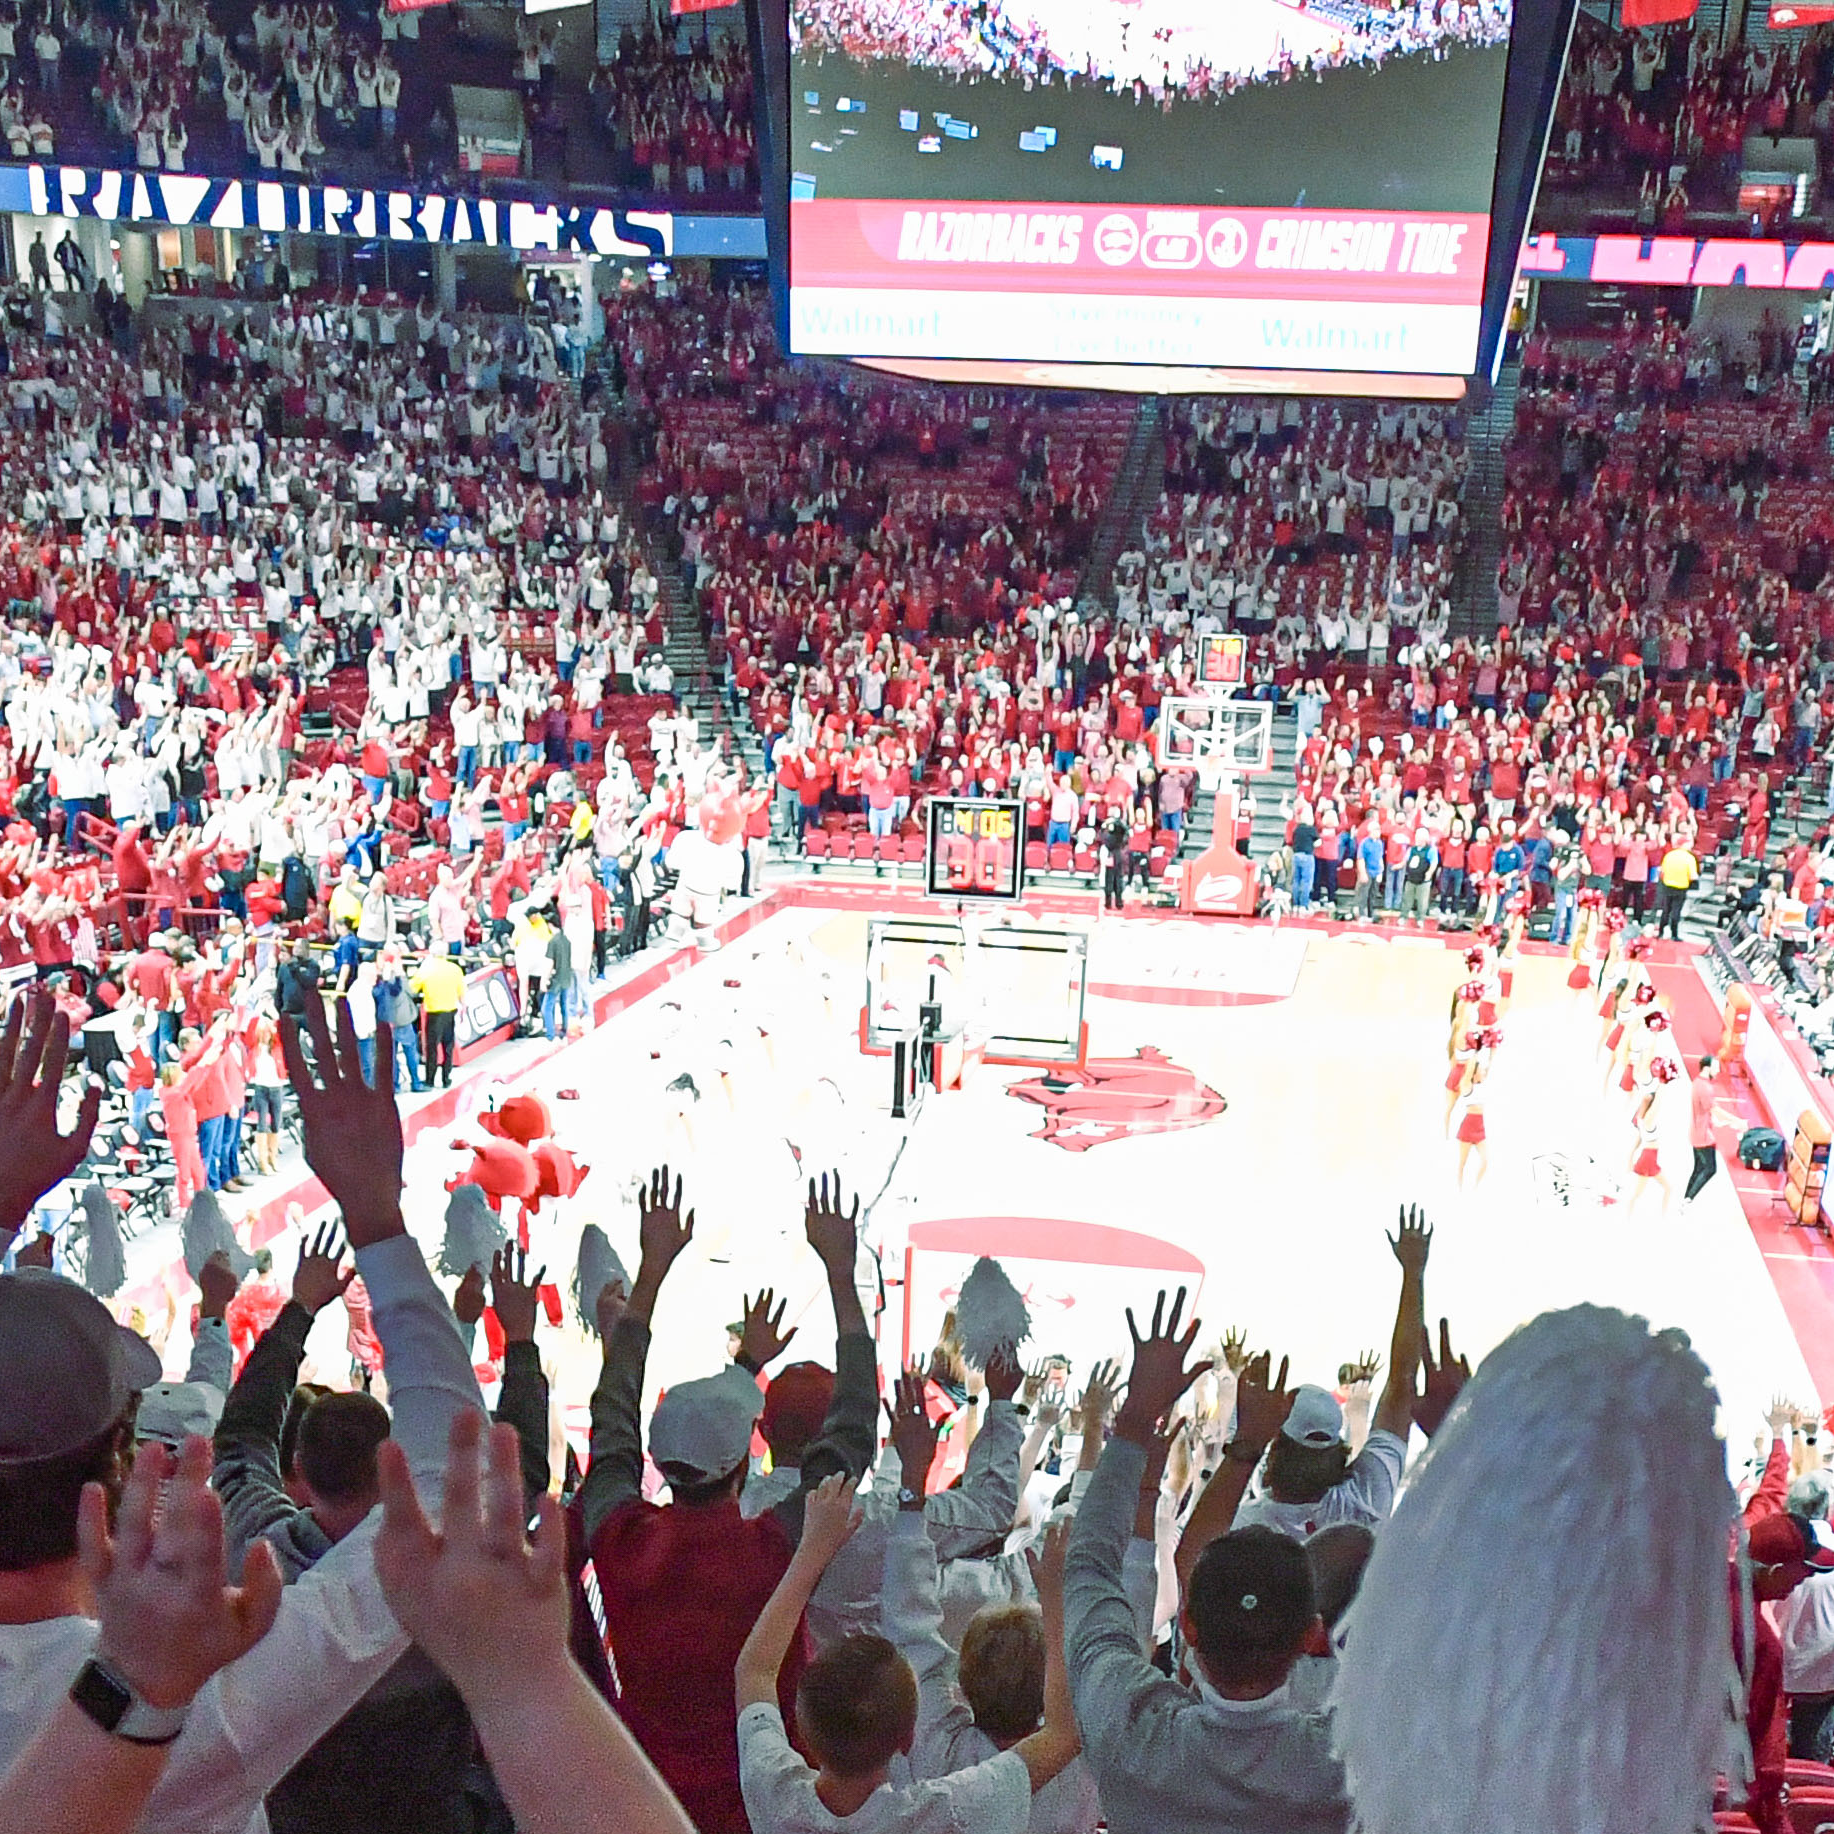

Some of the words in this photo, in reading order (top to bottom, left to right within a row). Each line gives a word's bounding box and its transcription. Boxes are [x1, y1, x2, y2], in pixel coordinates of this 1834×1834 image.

[897, 211, 1084, 264] RAZORBACKS
[1254, 219, 1395, 272] CRIMSON
[1397, 223, 1468, 274] TIDE
[800, 306, 942, 336] Walmart
[1261, 318, 1409, 351] Walmart
